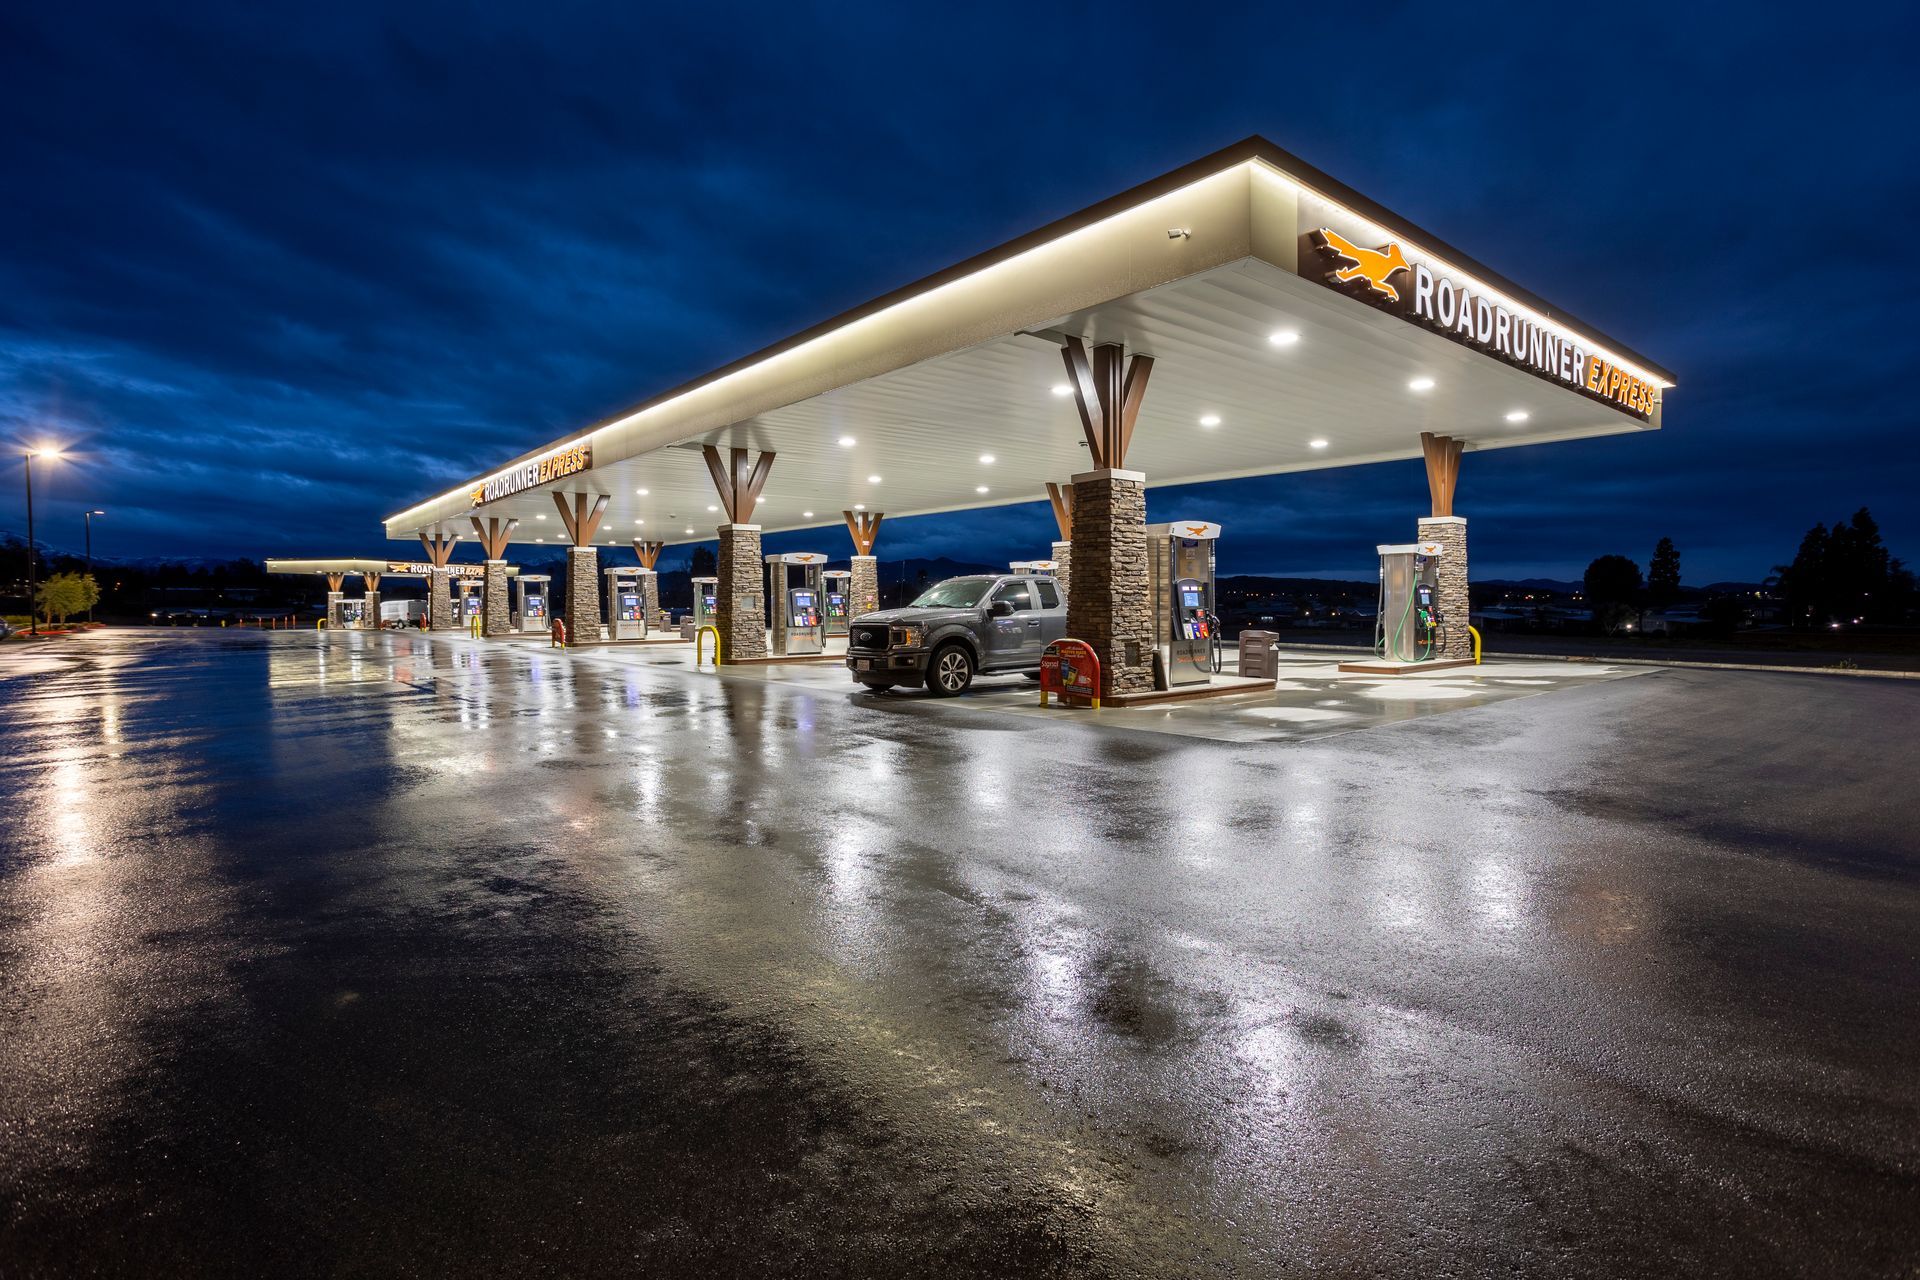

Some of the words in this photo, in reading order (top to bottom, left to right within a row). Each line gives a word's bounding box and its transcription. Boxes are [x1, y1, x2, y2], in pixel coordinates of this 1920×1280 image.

[1414, 262, 1586, 388] ROADRUNNER
[1586, 355, 1655, 416] EXPRESS
[484, 463, 540, 502] ROADRUNNER
[540, 445, 586, 483] EXPRESS
[410, 564, 465, 575] ROADNNER
[465, 567, 485, 576] EXPR
